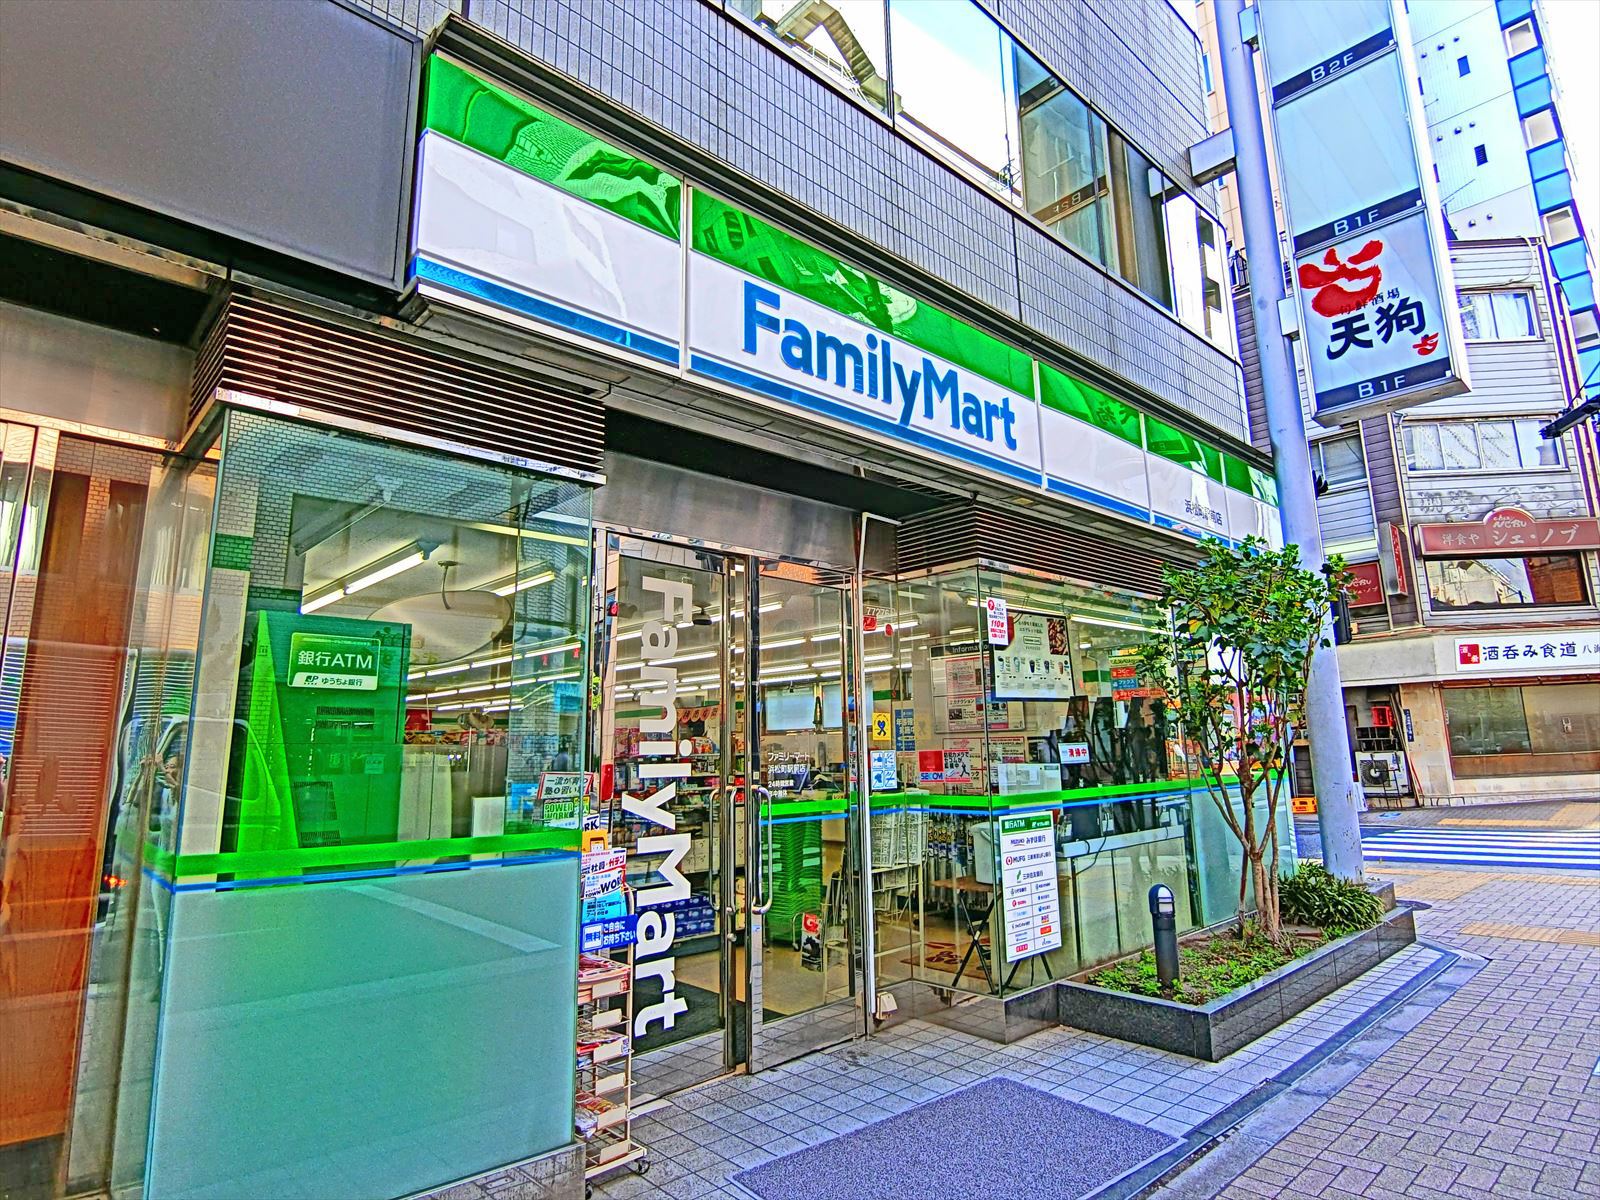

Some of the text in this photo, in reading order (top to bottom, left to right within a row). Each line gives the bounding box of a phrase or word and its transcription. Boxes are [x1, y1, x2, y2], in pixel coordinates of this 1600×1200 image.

[1311, 52, 1354, 82] B2F
[1333, 209, 1379, 236] B1F
[1326, 296, 1426, 360] 天狗
[742, 280, 1017, 451] FamilyMart
[1357, 374, 1406, 399] B1F
[1442, 523, 1579, 546] 洋食や シェ・ノブ
[297, 650, 373, 669] 銀行ATM
[1482, 641, 1577, 661] 酒呑み食道
[321, 678, 363, 687] ゆうちょ銀行
[767, 751, 810, 762] ファミリーマート
[920, 772, 943, 780] SECOM
[622, 576, 693, 1037] FamilyMart
[603, 921, 625, 932] ご自由に
[603, 930, 636, 945] お持ち下さい
